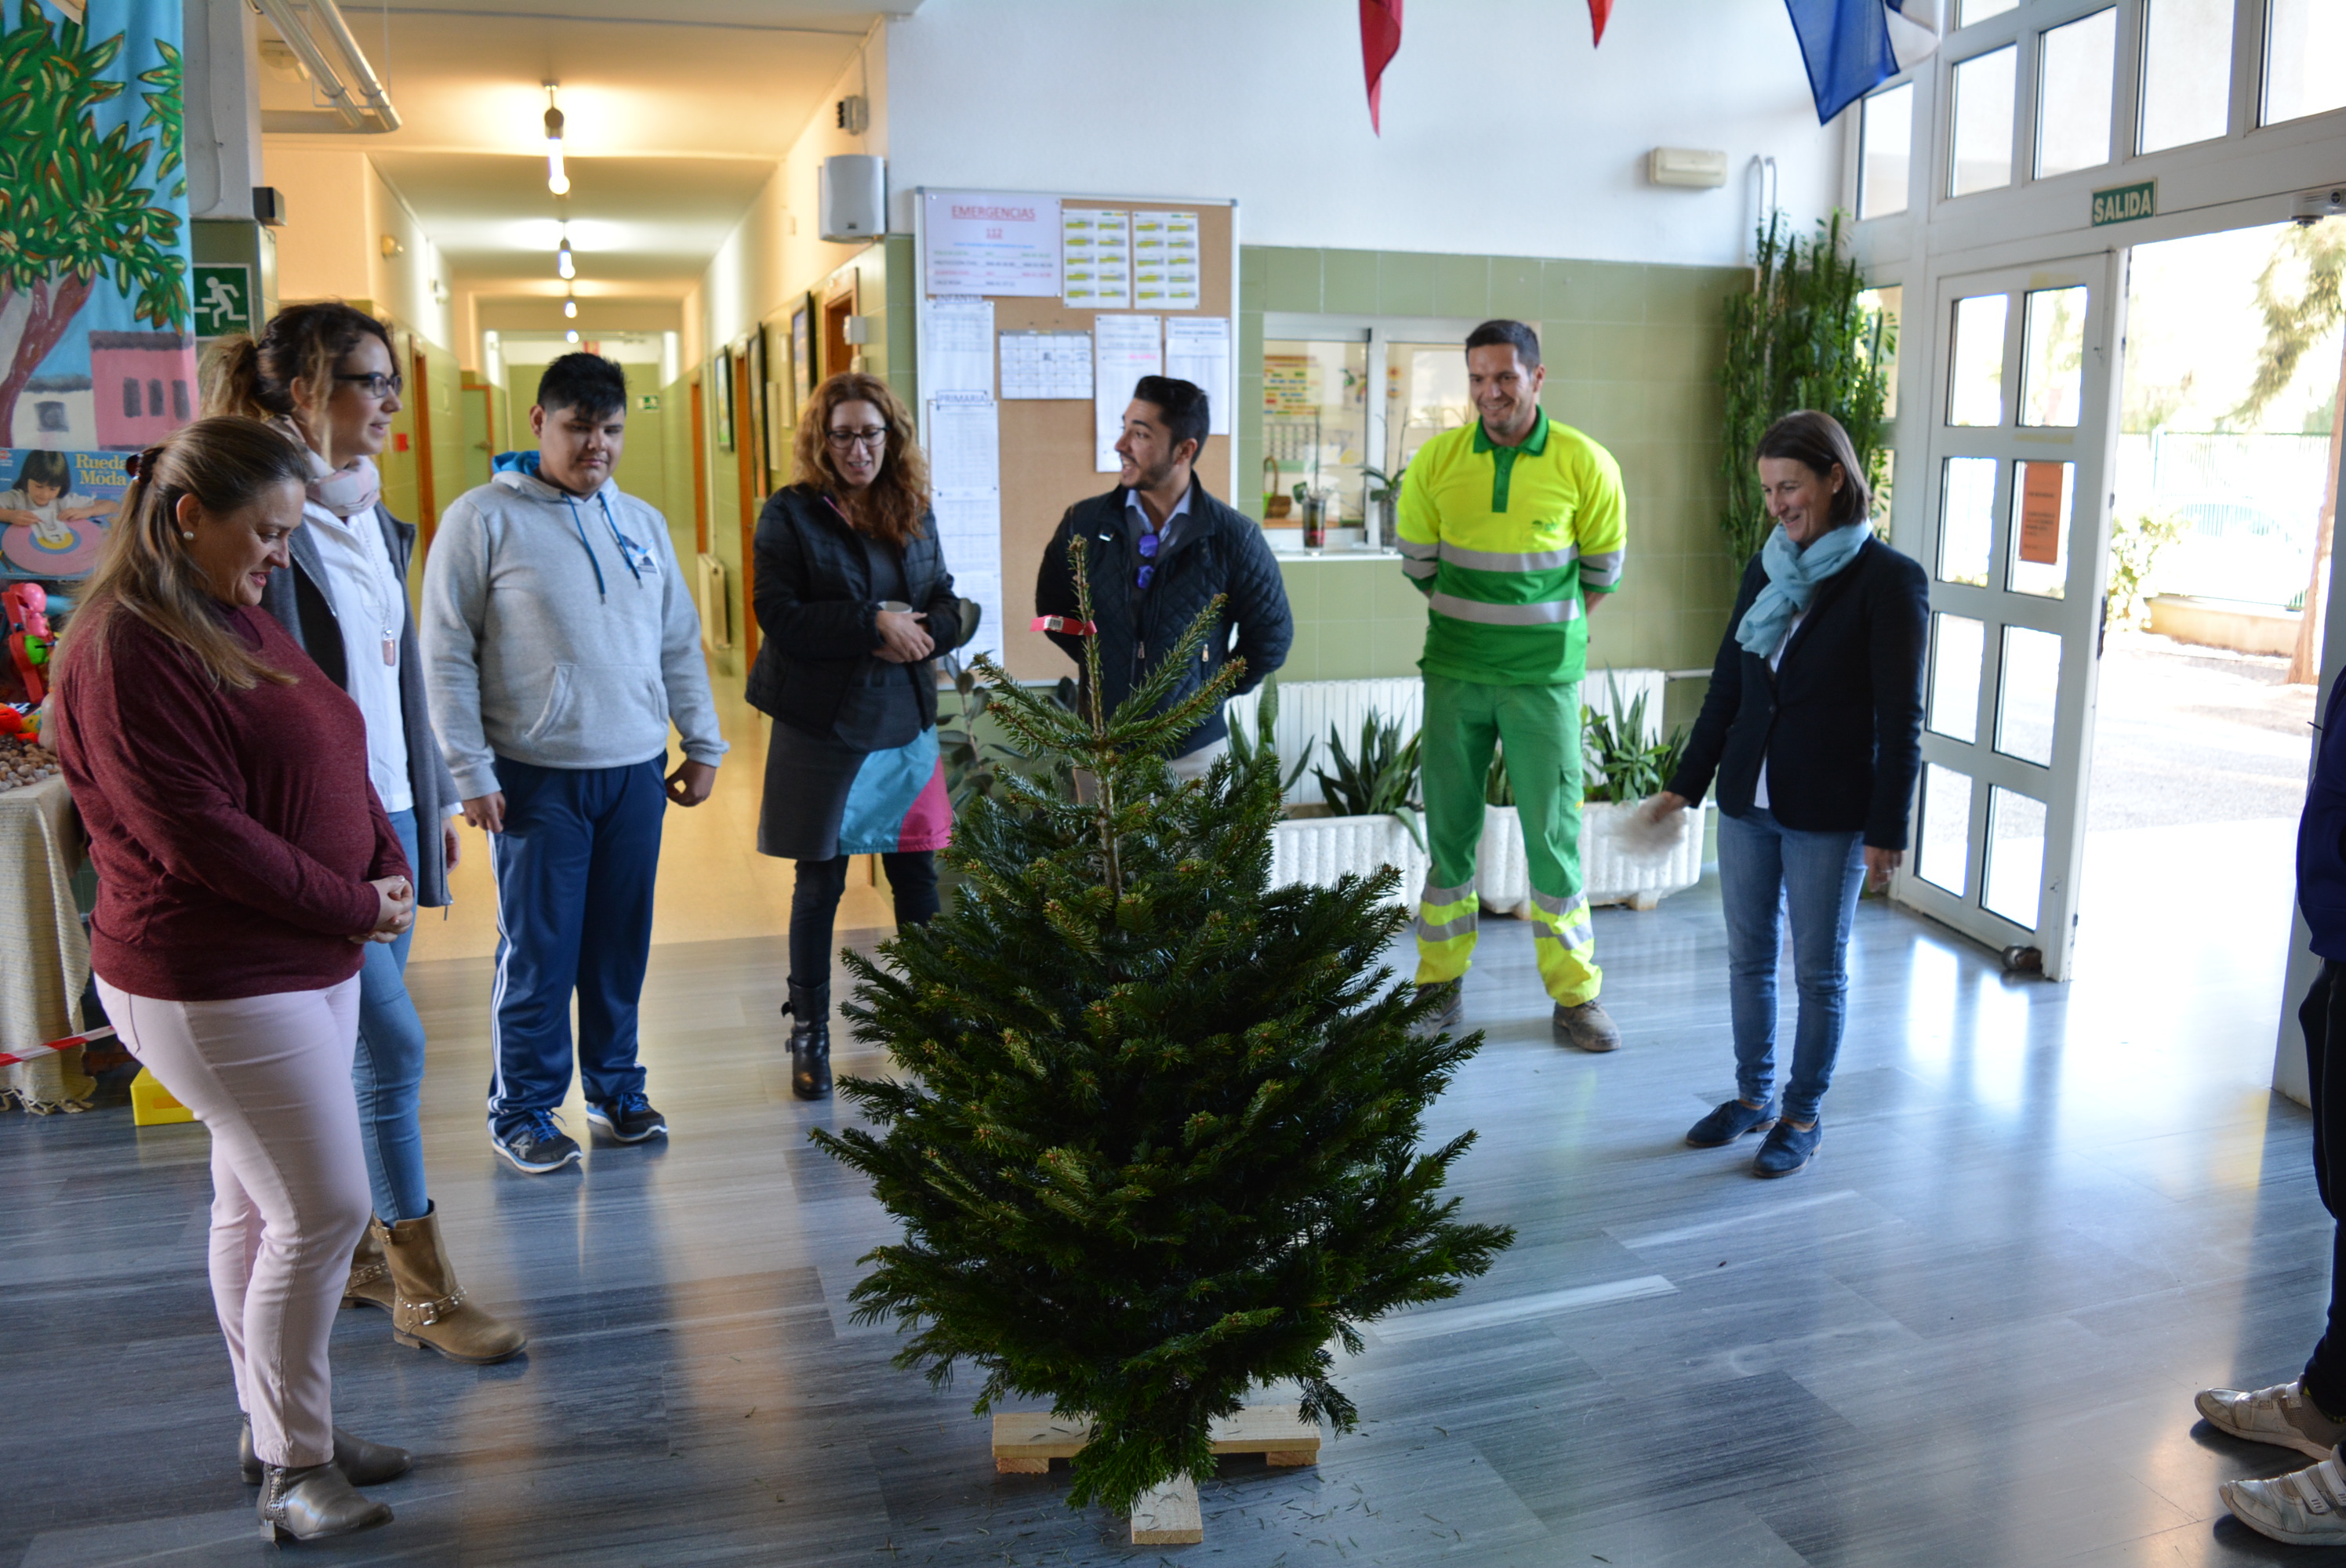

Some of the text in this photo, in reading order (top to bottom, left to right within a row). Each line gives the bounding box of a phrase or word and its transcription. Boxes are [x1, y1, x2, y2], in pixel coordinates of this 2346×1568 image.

[952, 205, 1036, 220] EMERGENCIAS
[2094, 189, 2152, 223] SALIDA
[986, 228, 1003, 238] 112
[939, 394, 986, 403] PRIMARIA
[74, 453, 126, 470] Rueda
[79, 470, 126, 486] Moda
